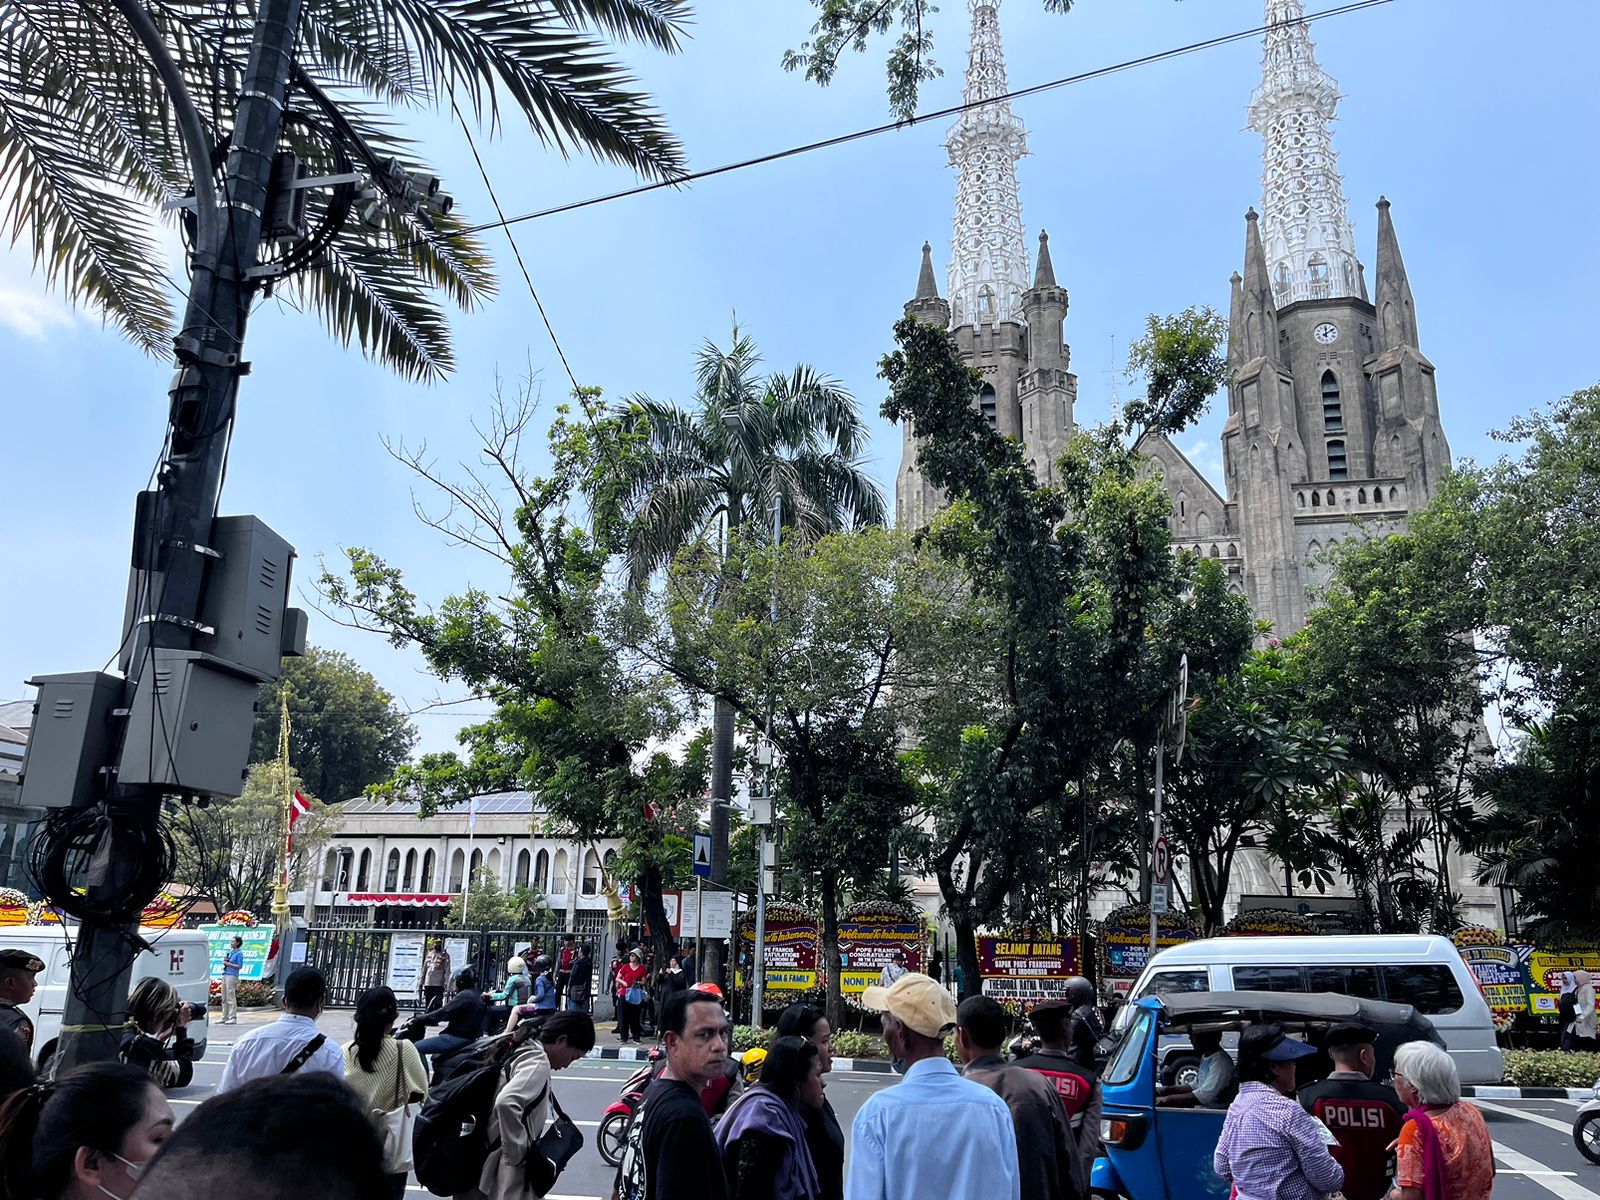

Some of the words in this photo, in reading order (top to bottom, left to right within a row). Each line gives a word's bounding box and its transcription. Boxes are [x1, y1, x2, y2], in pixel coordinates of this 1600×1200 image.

[838, 928, 873, 940] Welcome
[881, 928, 919, 940] Indonesia
[1105, 931, 1141, 944] Welcome
[995, 943, 1030, 955] SELAMAT
[1033, 943, 1062, 956] DATANG
[1029, 961, 1062, 969] FRANSISKUS
[1539, 957, 1570, 967] WELCOME
[1018, 968, 1048, 976] INDONESIA
[789, 974, 810, 982] FAMILY
[843, 977, 865, 986] NONI
[1502, 986, 1525, 997] ANWA
[1324, 1105, 1386, 1128] POLISI
